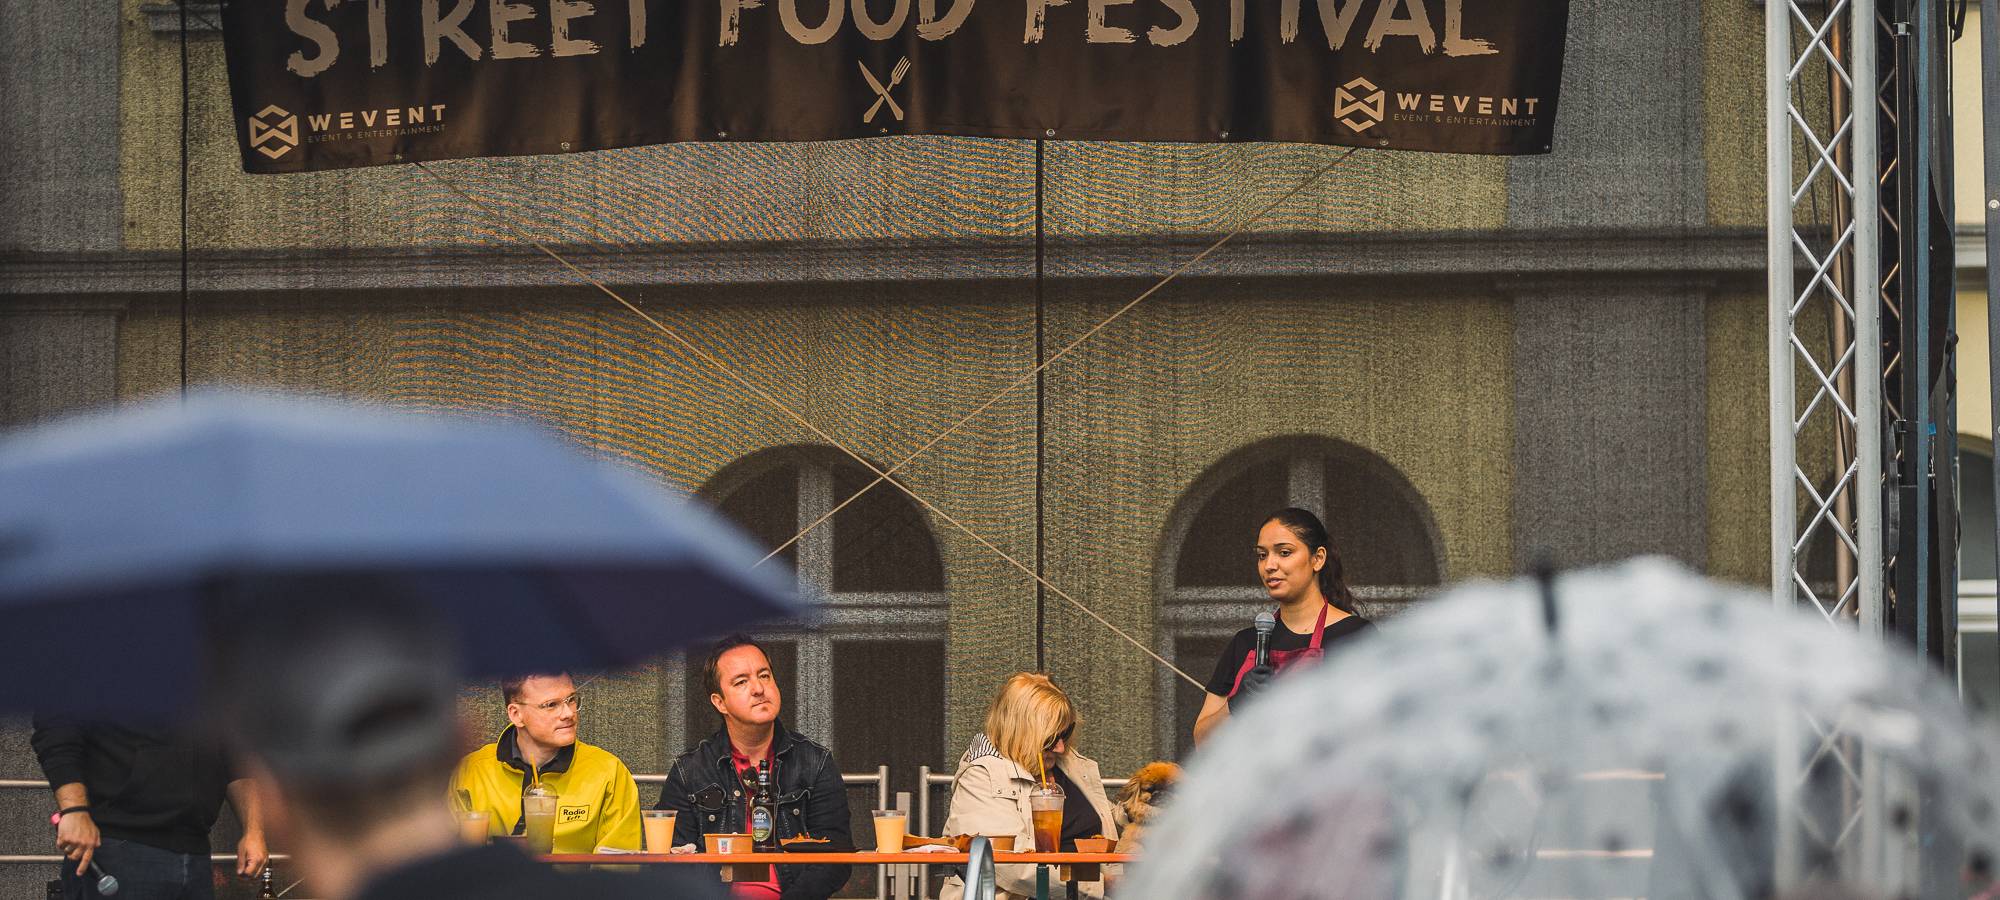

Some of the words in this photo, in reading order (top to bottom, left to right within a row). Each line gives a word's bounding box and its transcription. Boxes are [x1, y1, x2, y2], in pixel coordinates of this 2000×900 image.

[1397, 93, 1538, 115] WEVENT
[308, 104, 446, 132] WEVENT
[1393, 113, 1431, 122] EVENT
[1435, 115, 1442, 124] &
[1446, 117, 1537, 127] ENTERTAINMENT
[308, 132, 341, 143] EVENT
[357, 124, 446, 139] ENTERTAINMENT
[563, 808, 586, 816] Radio
